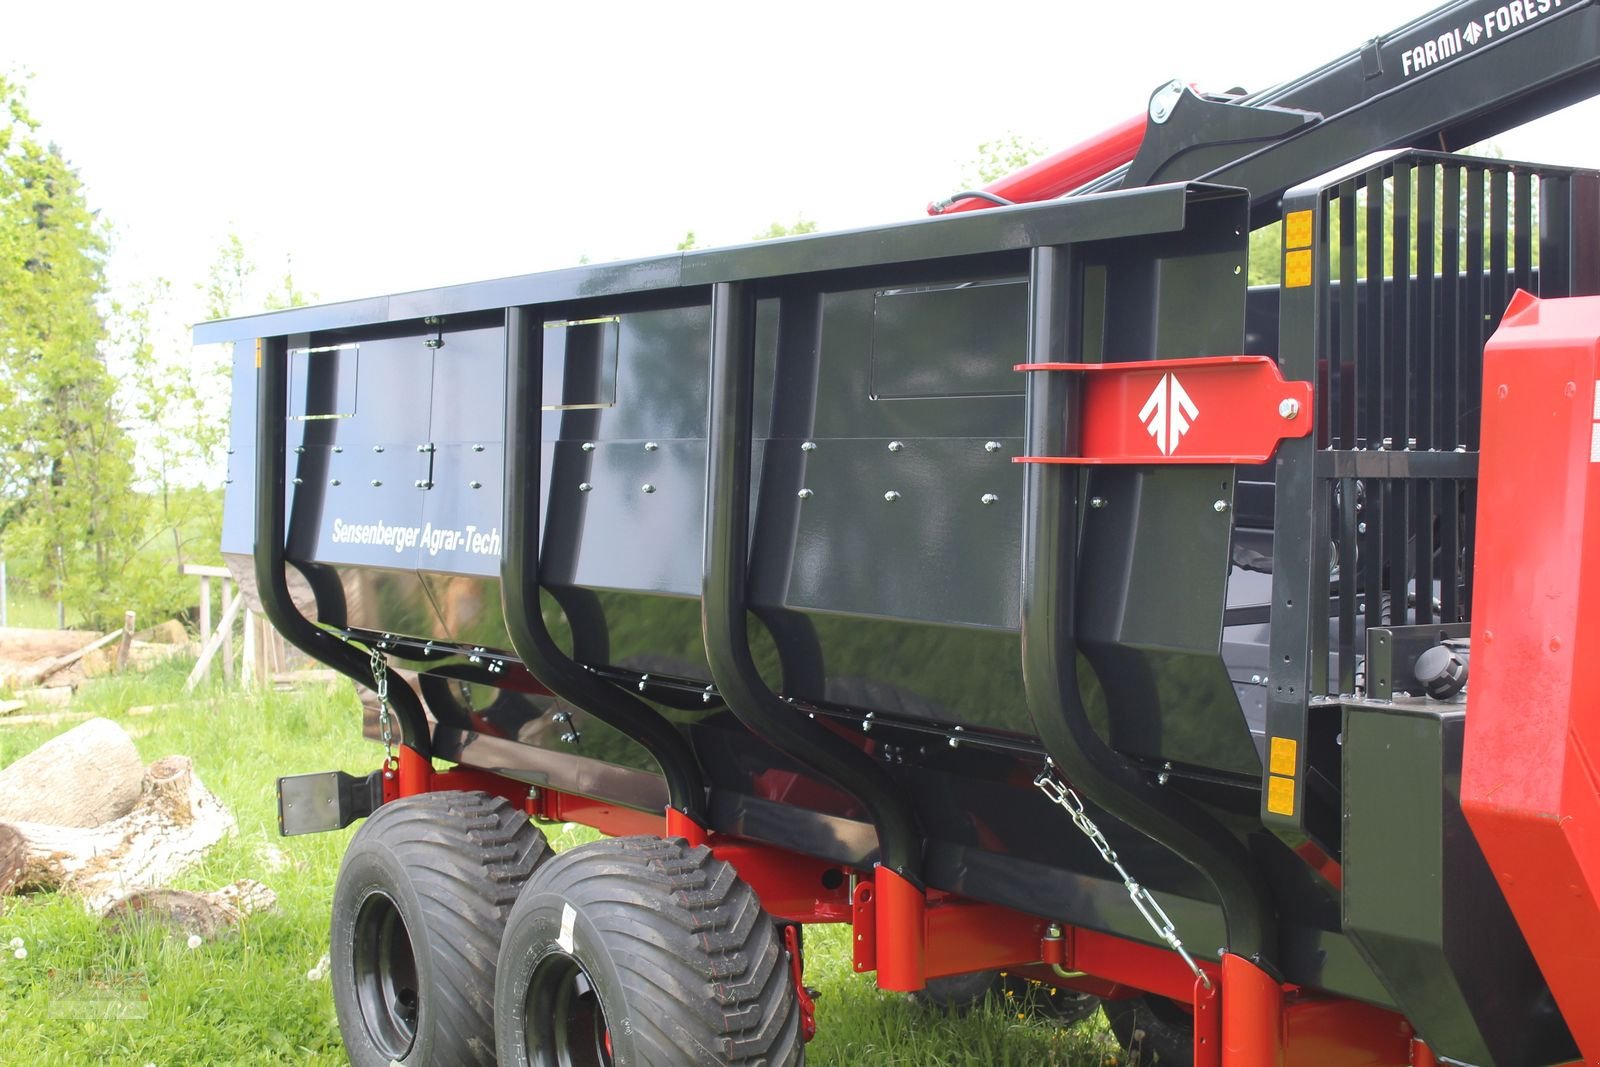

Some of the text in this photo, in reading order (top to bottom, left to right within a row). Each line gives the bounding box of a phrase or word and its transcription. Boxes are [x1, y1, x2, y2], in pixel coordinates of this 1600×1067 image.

[1401, 0, 1561, 76] FARMI FORES
[332, 518, 502, 556] Sensenberger Agrar-Tech
